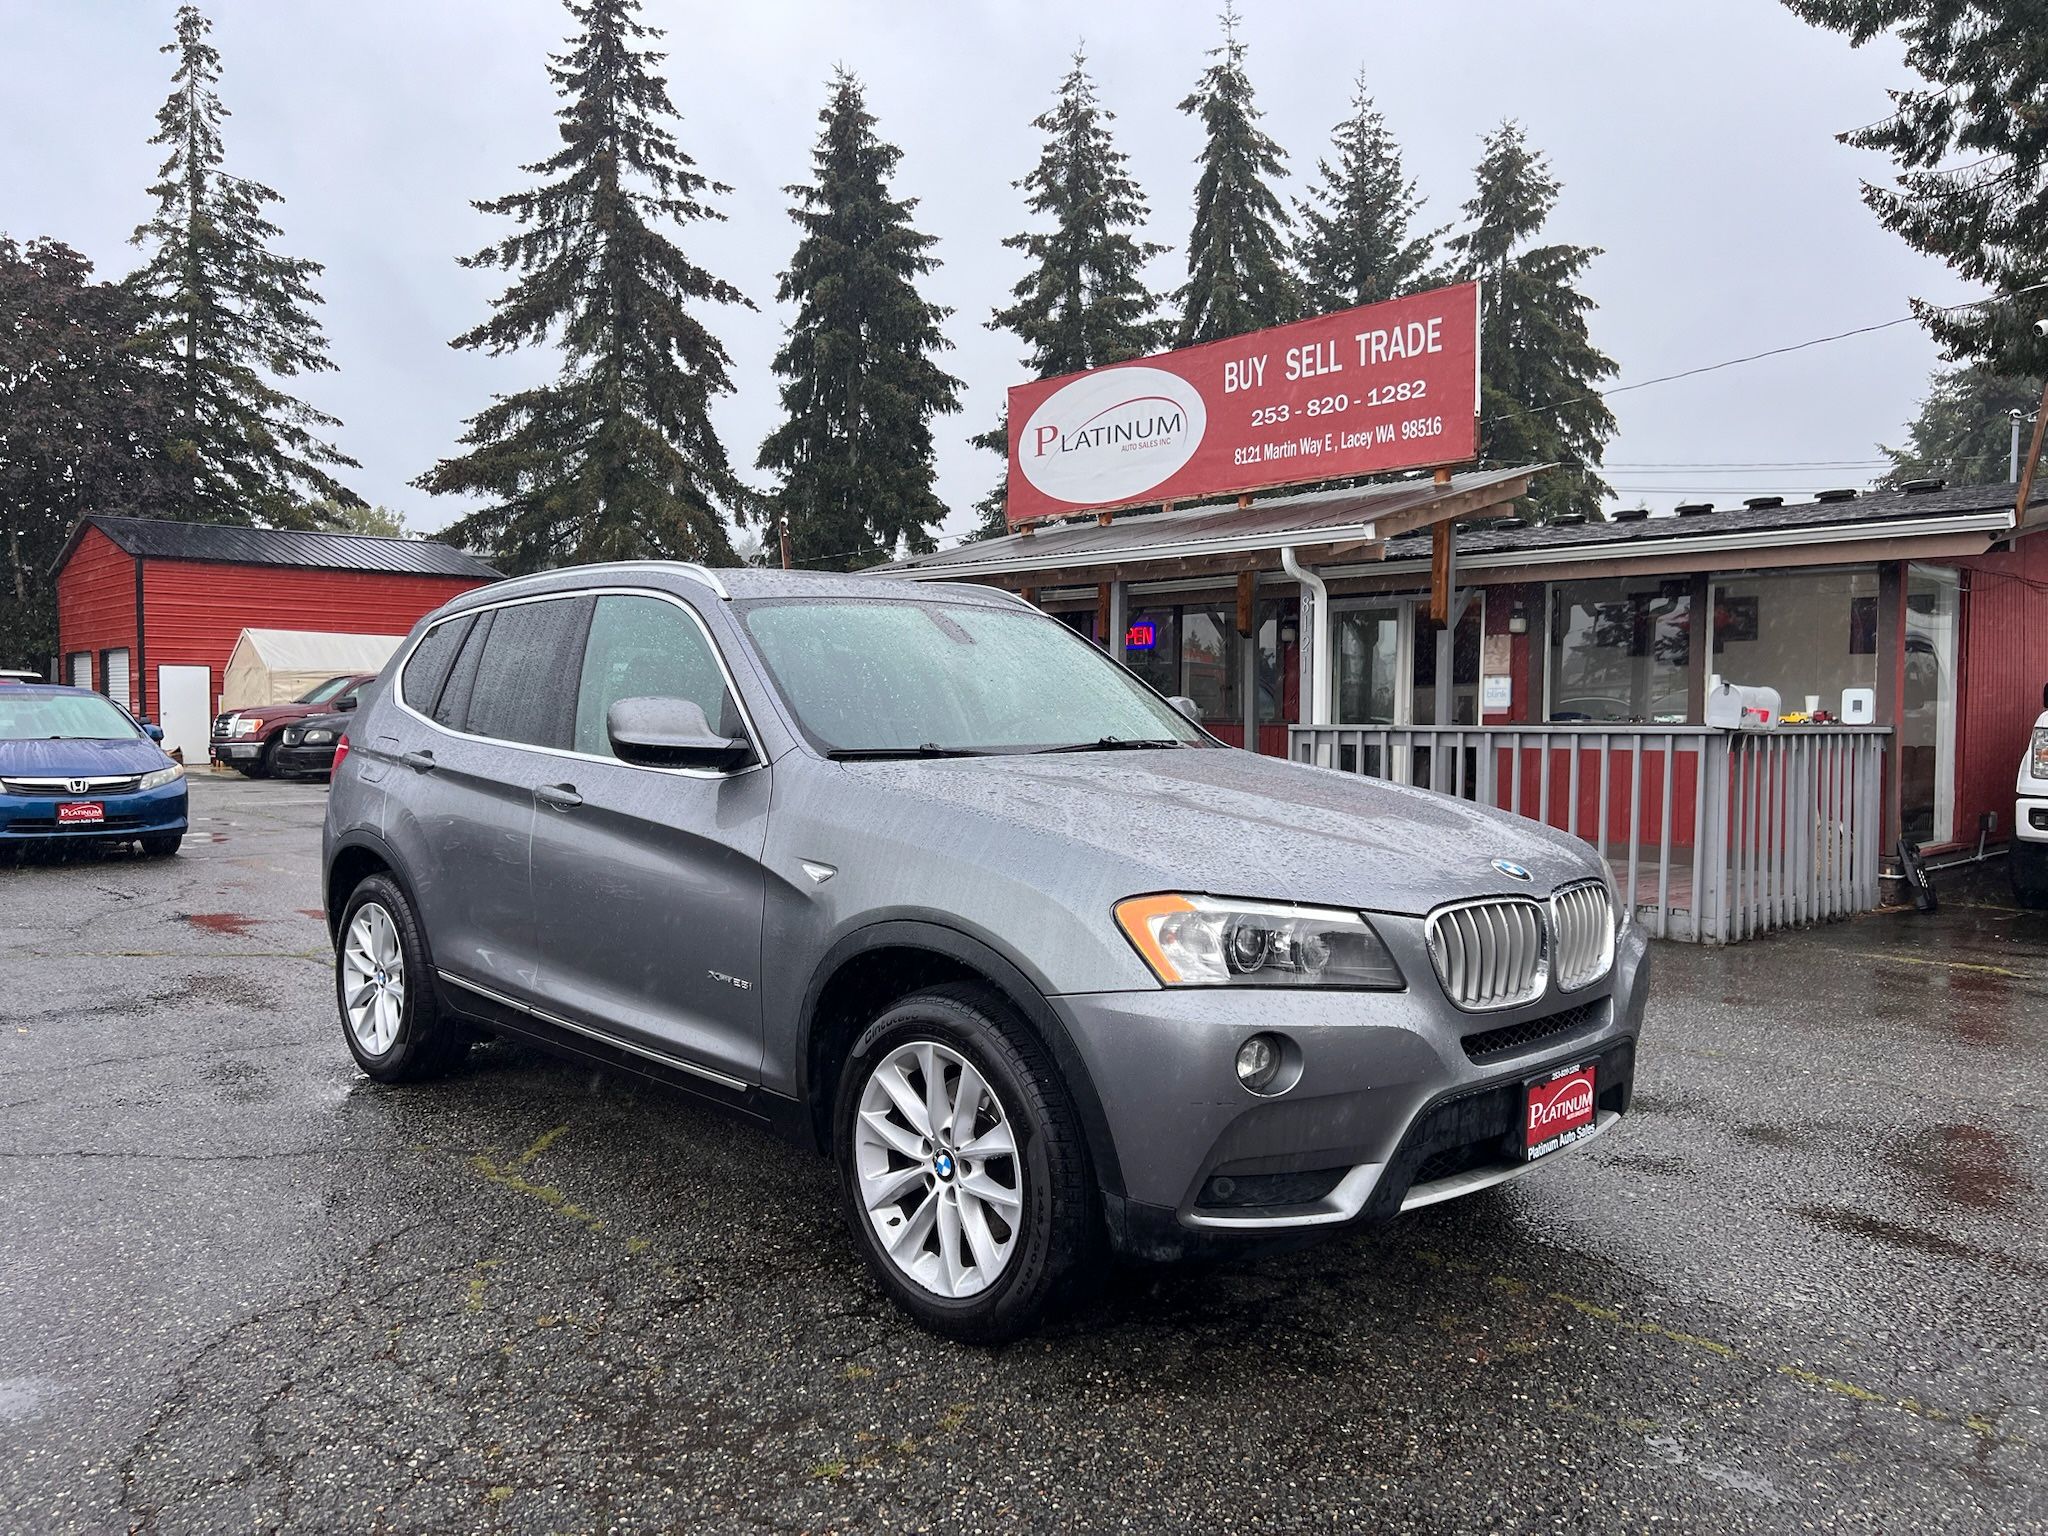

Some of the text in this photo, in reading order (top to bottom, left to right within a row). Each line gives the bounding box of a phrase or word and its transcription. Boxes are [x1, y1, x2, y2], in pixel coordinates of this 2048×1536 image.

[1224, 316, 1443, 394] BUY SELL TRADE
[1251, 404, 1290, 427] 253
[1306, 393, 1349, 417] 820
[1367, 379, 1427, 407] 1282
[1034, 413, 1182, 458] PLATINUM
[1121, 436, 1172, 453] AUTO SALES INC
[1234, 445, 1262, 466] 8121
[1263, 440, 1298, 461] Martin
[1299, 436, 1323, 457] Way
[1340, 431, 1374, 450] Lacey
[1375, 423, 1396, 444] WA
[1401, 415, 1443, 440] 98516
[1125, 626, 1153, 646] PEN
[1300, 596, 1311, 674] 8121
[1529, 1092, 1593, 1129] PLATINUM
[1527, 1123, 1596, 1162] Platinum Auto Sales
